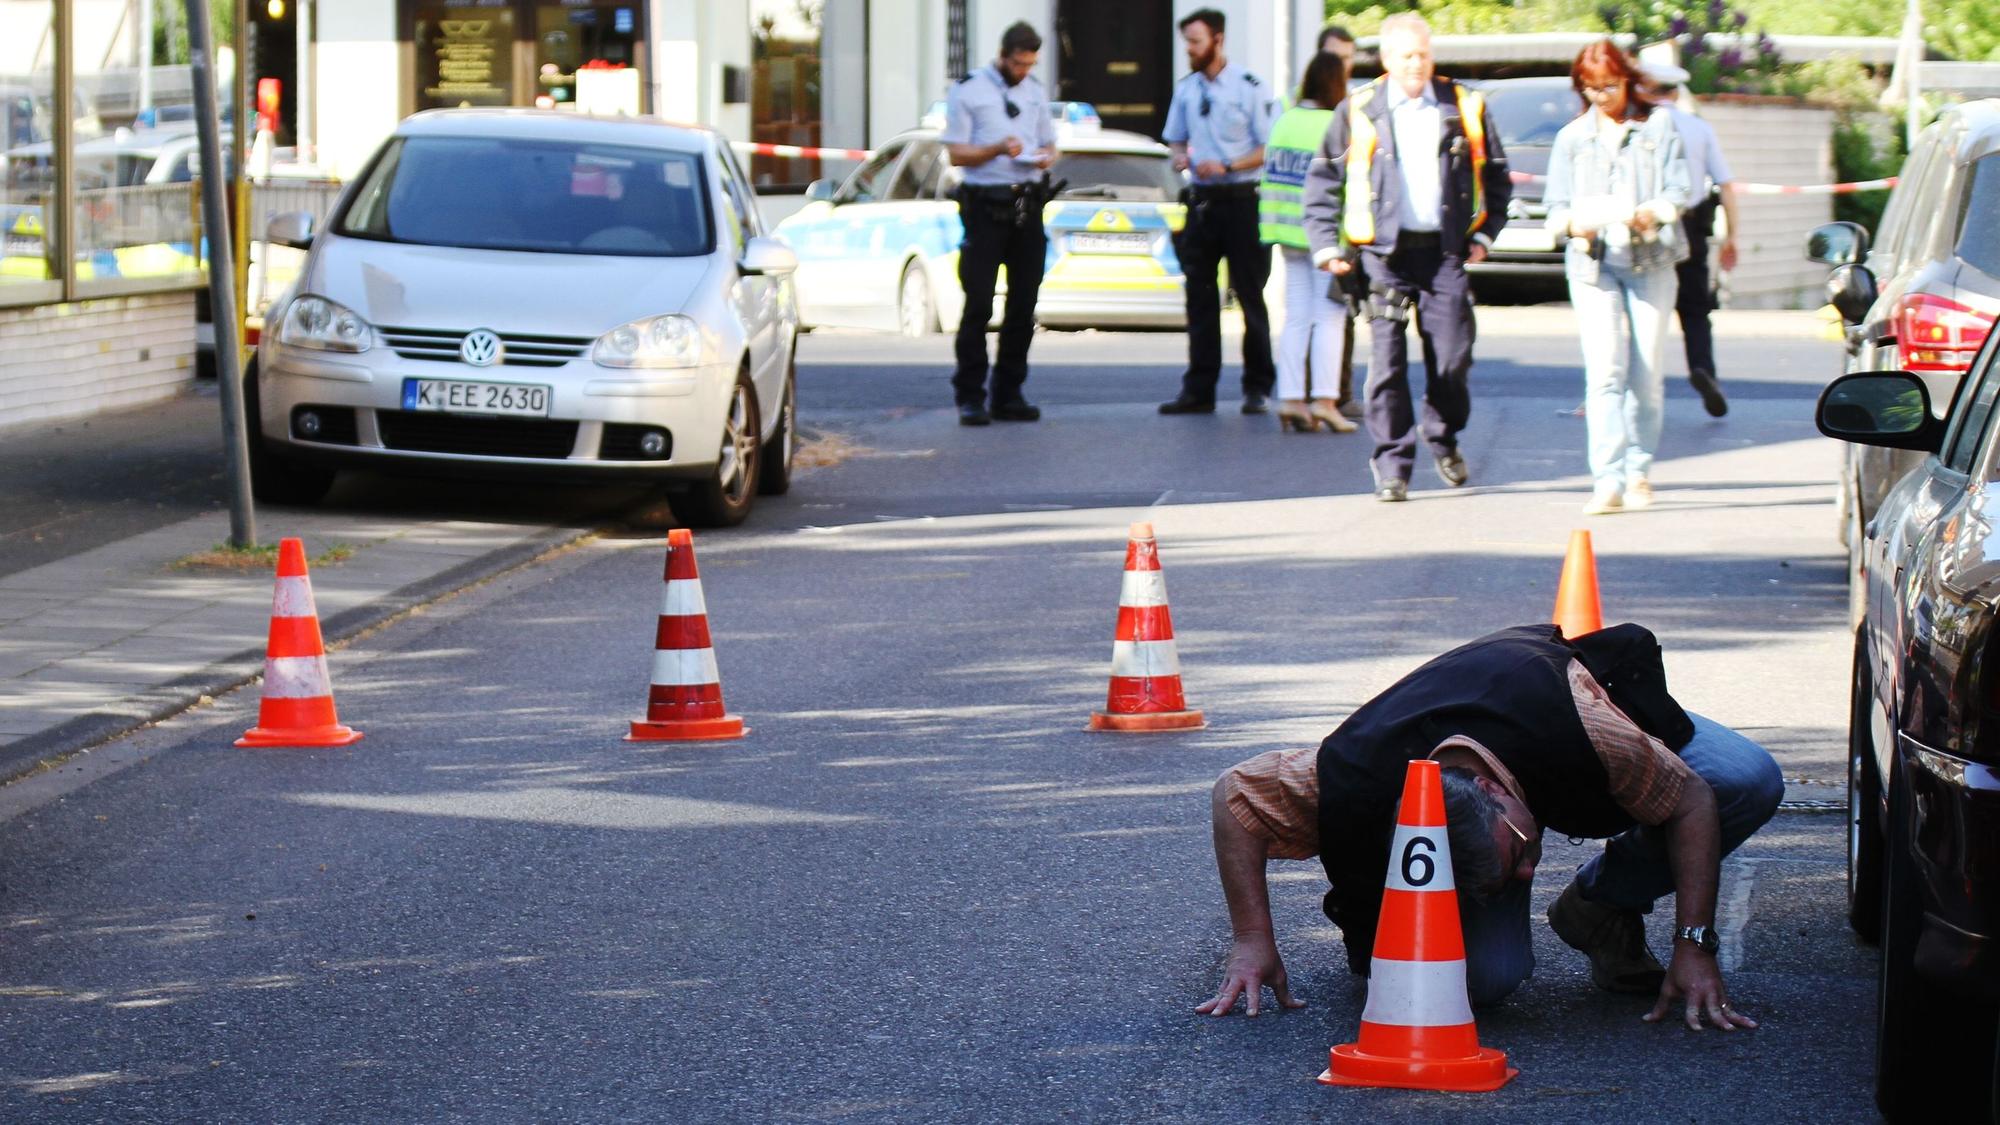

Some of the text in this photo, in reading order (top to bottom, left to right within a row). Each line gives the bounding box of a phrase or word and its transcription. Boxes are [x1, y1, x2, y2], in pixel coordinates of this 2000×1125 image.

[1268, 148, 1313, 176] POLIZE
[485, 386, 544, 411] 2630
[1401, 836, 1436, 887] 6
